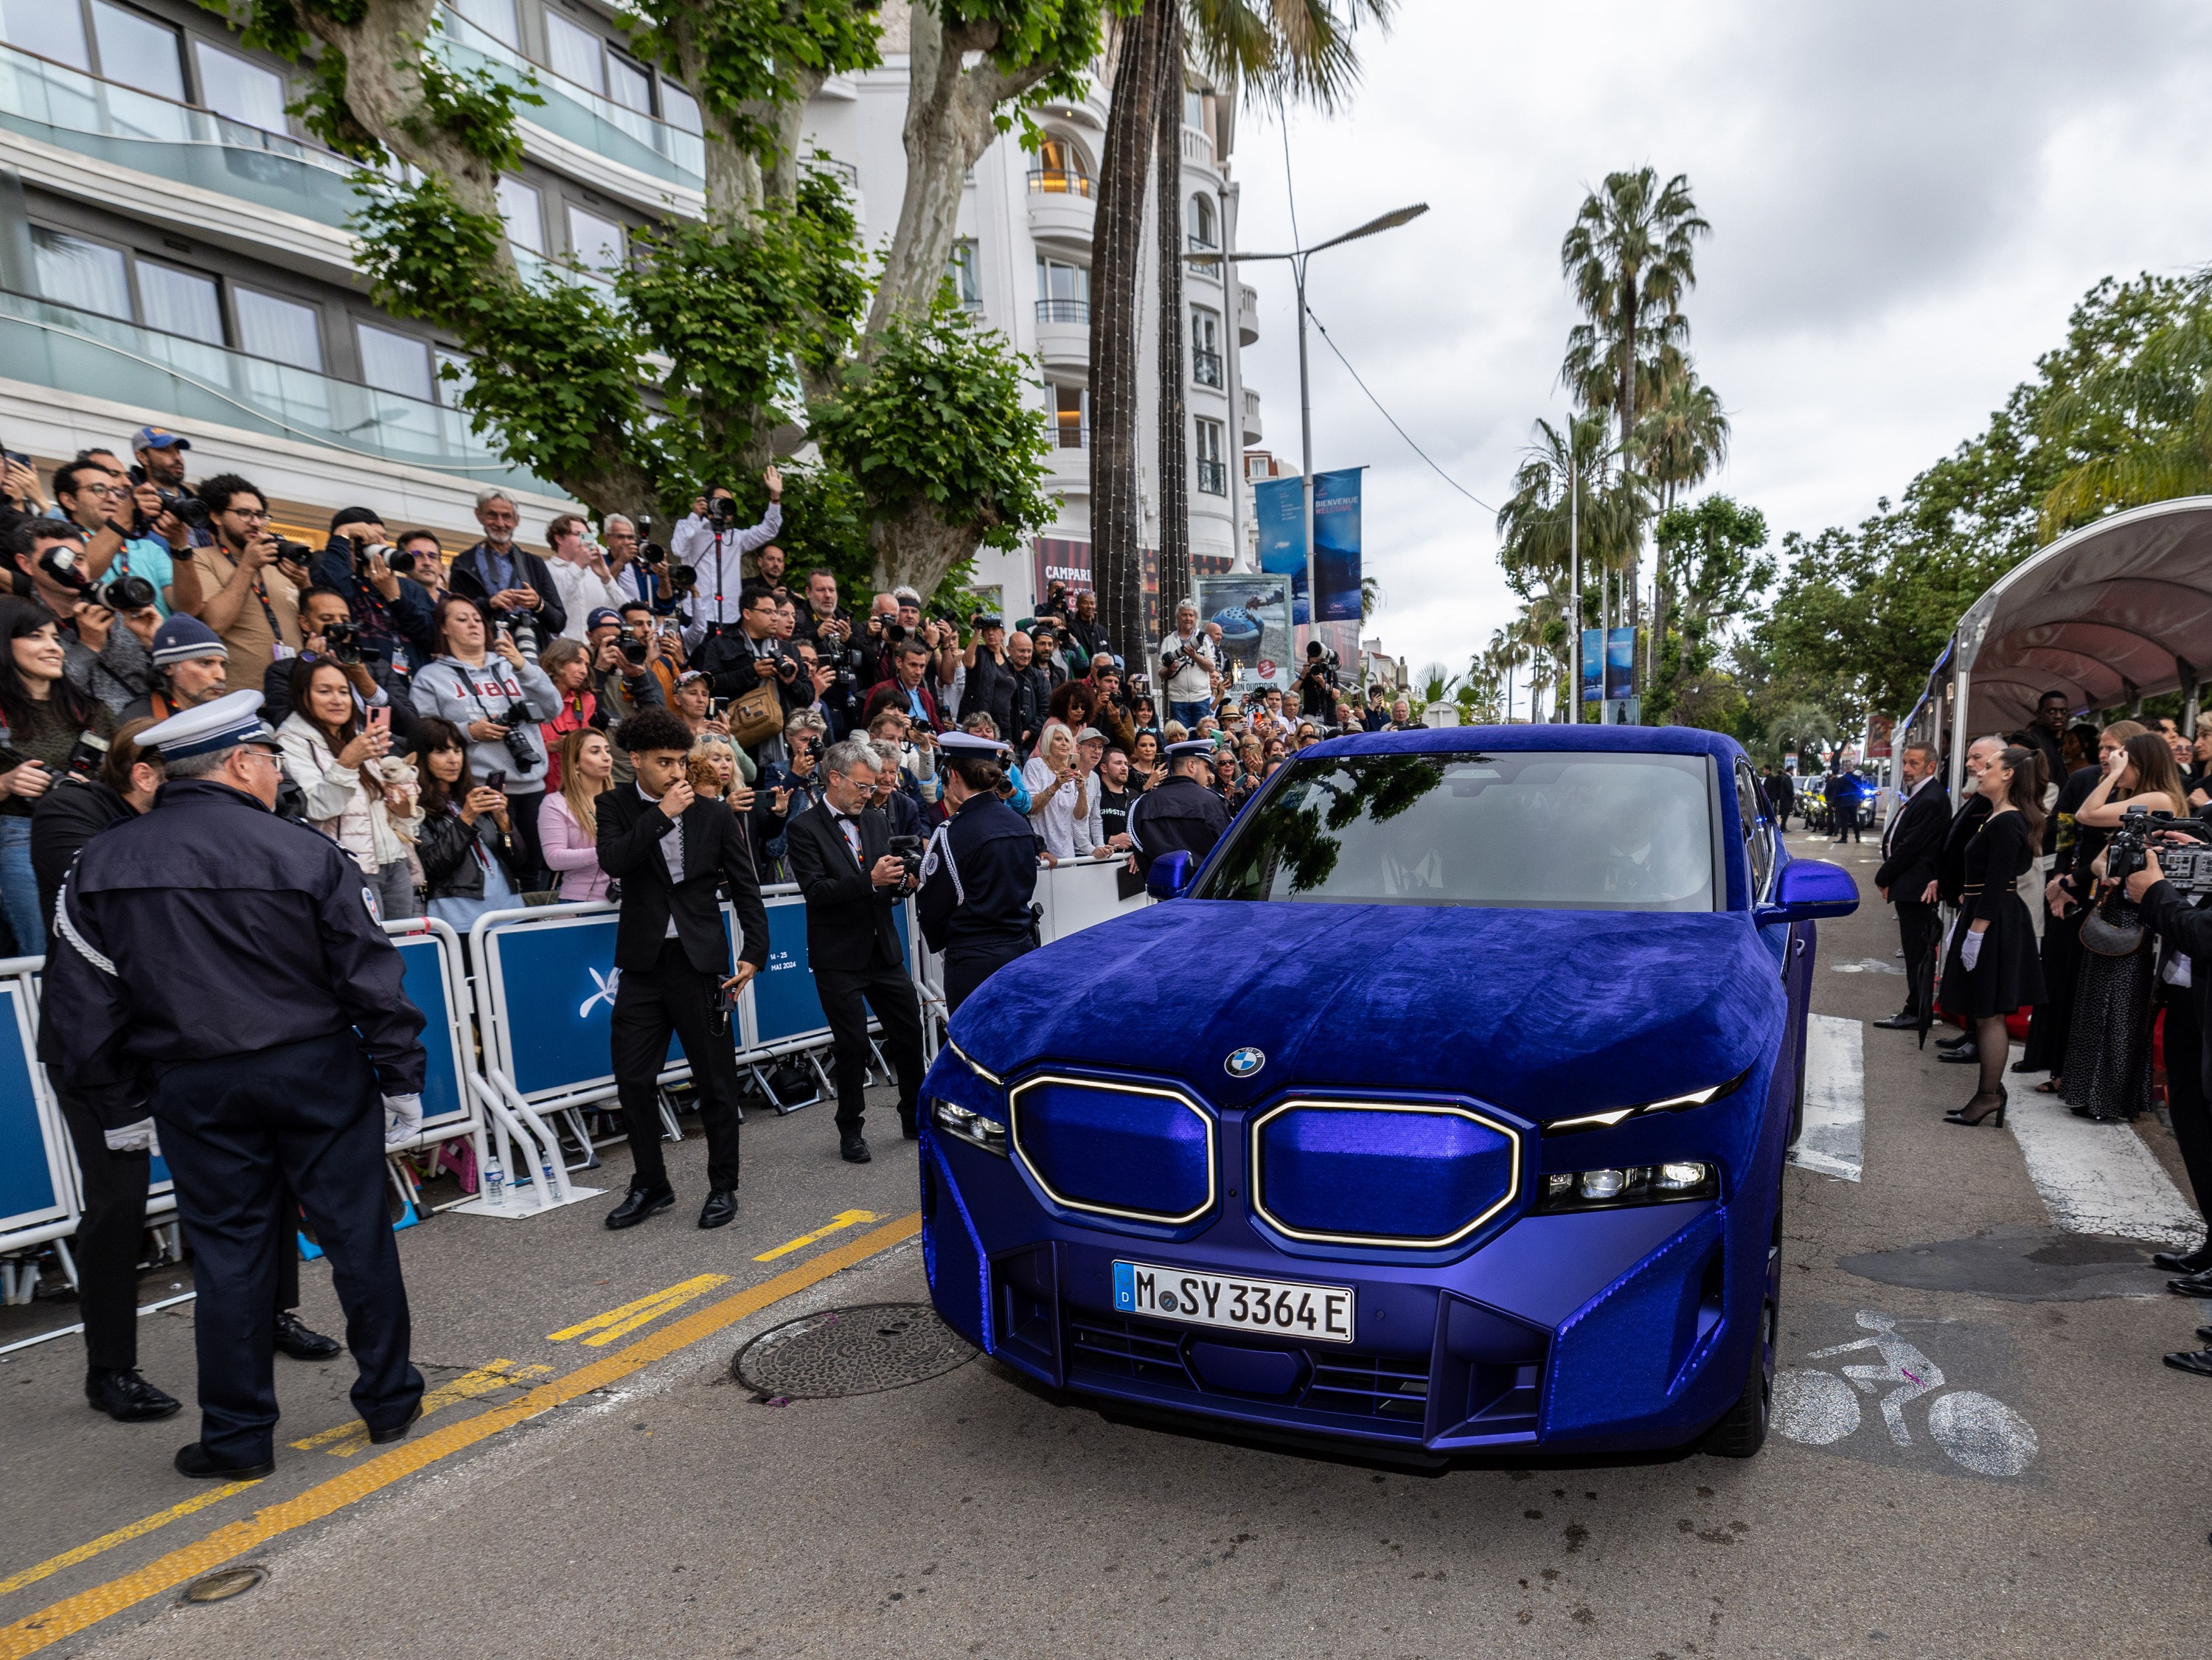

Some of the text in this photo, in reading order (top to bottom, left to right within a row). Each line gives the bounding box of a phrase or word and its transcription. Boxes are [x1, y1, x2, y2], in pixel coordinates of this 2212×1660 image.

[1315, 496, 1359, 507] BIENVENUE
[1315, 504, 1352, 515] WELCOME
[1045, 565, 1091, 582] CAMPARI
[1231, 682, 1278, 692] MON QUOTIDIEN
[897, 873, 908, 891] SONY
[771, 961, 796, 971] MAI 2024
[1121, 1292, 1130, 1302] D
[1136, 1271, 1156, 1309] M
[1180, 1277, 1221, 1319] SY
